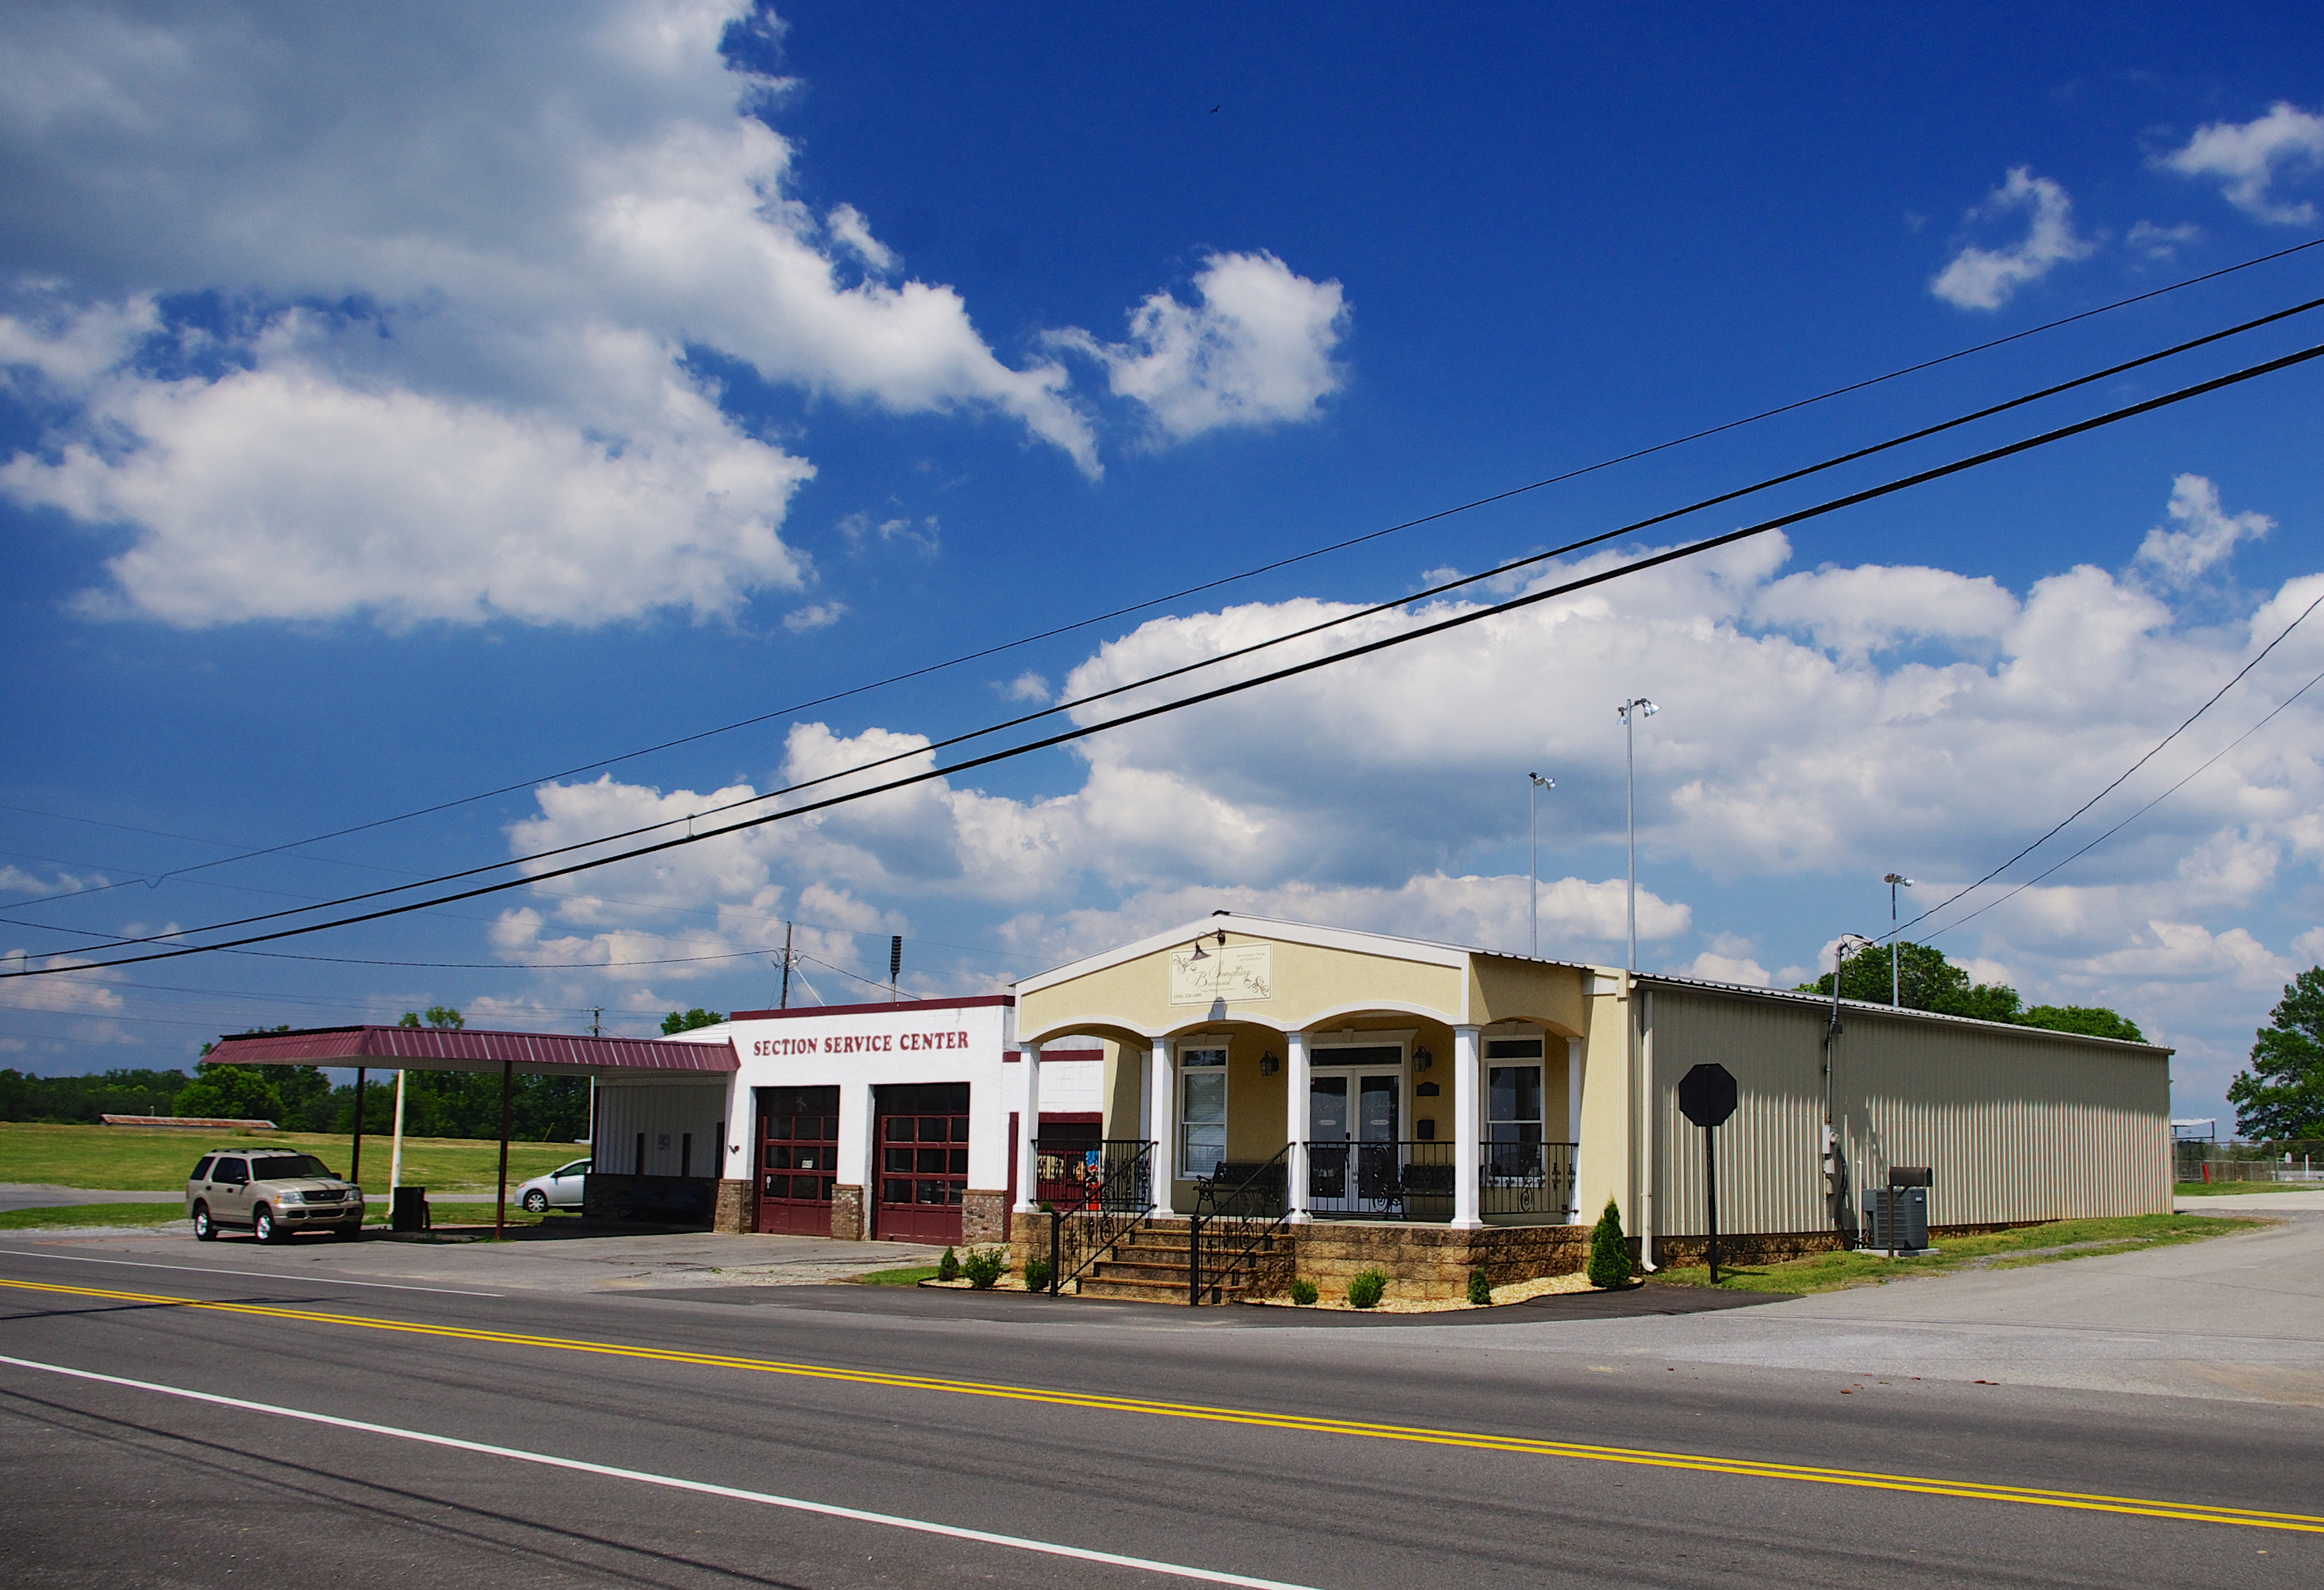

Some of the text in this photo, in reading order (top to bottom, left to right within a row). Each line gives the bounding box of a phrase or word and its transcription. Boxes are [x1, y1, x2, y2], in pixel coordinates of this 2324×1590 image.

[754, 1031, 969, 1055] SECTION SERVICE CENTER
